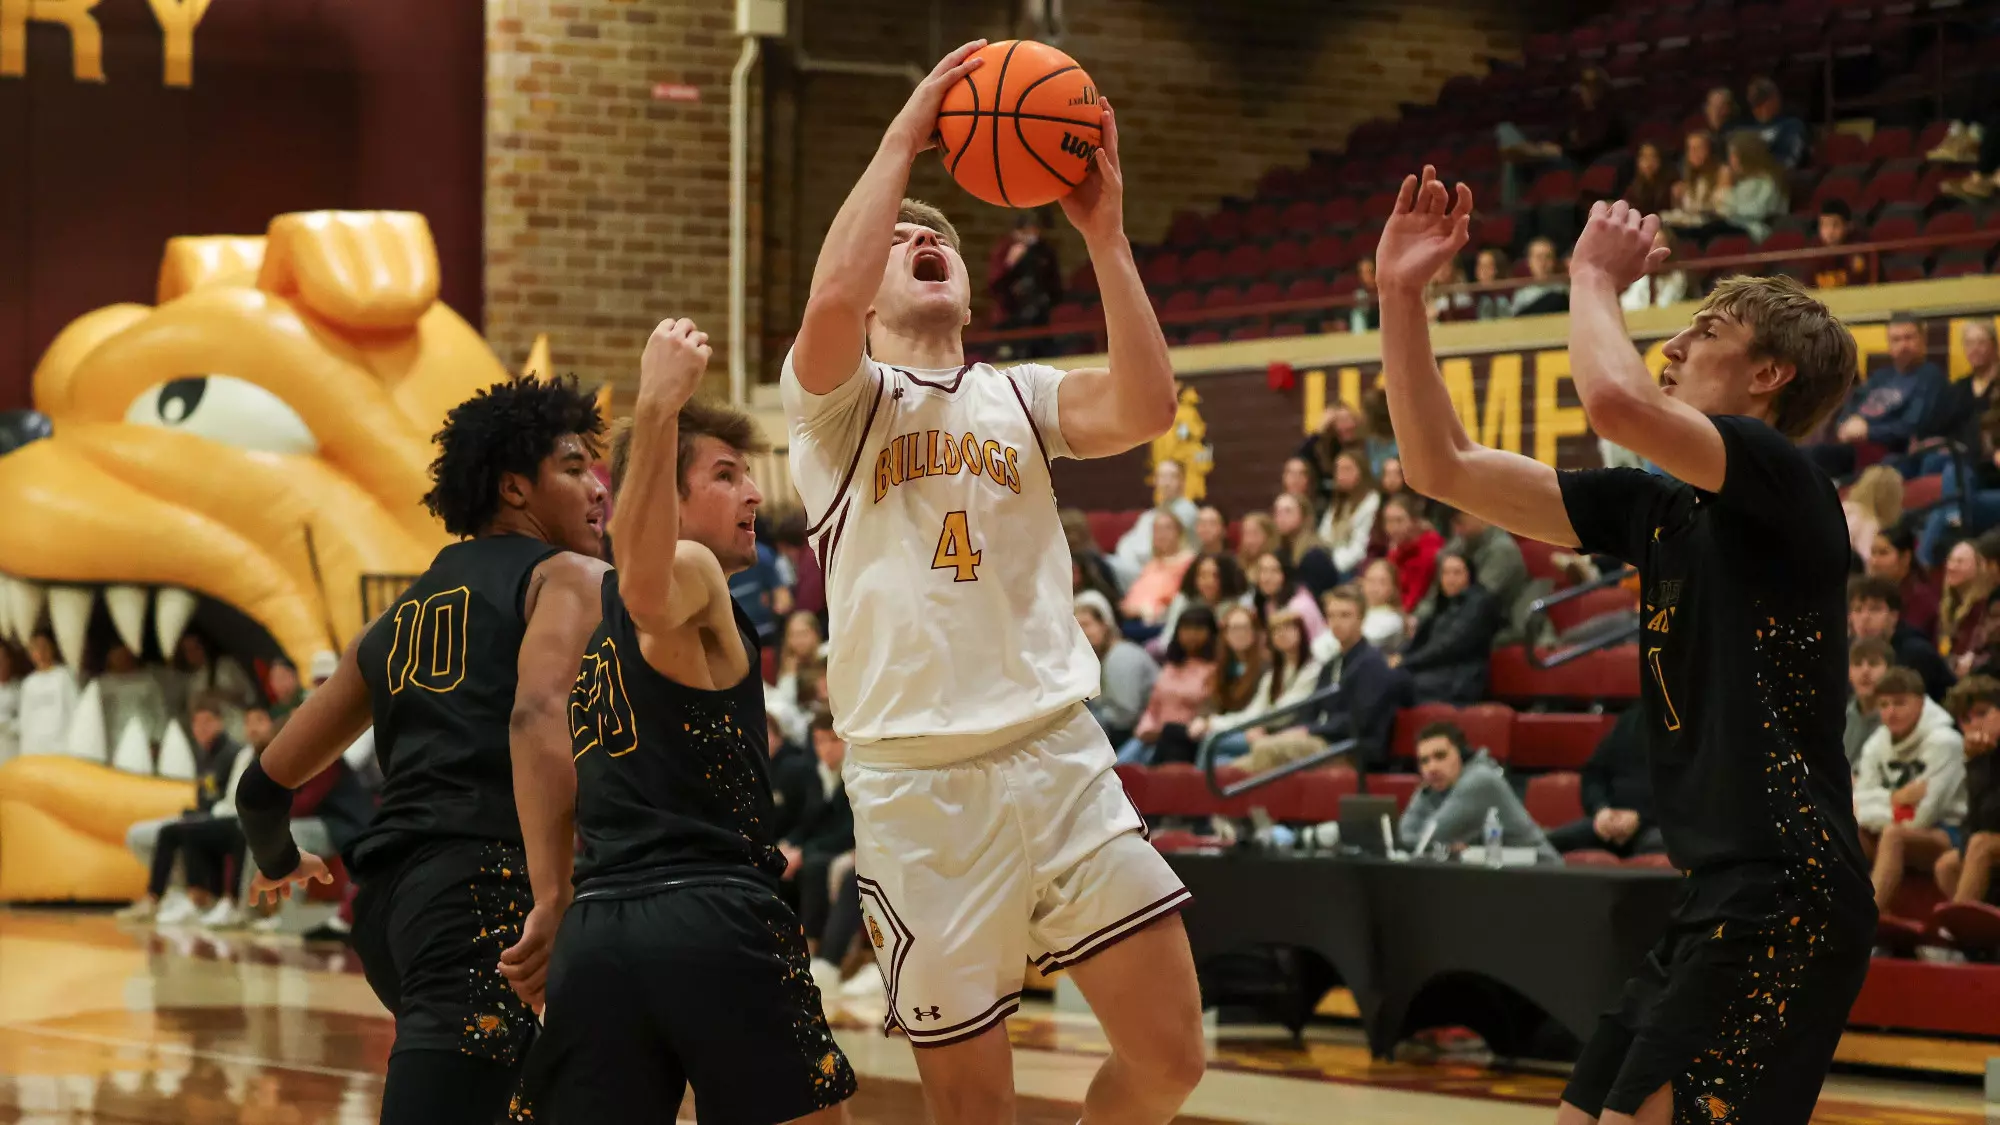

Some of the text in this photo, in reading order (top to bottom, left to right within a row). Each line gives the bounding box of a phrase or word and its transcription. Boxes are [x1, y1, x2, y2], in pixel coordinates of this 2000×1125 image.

[874, 429, 1022, 504] BULLDOGS
[930, 510, 983, 583] 4
[387, 586, 471, 695] 10
